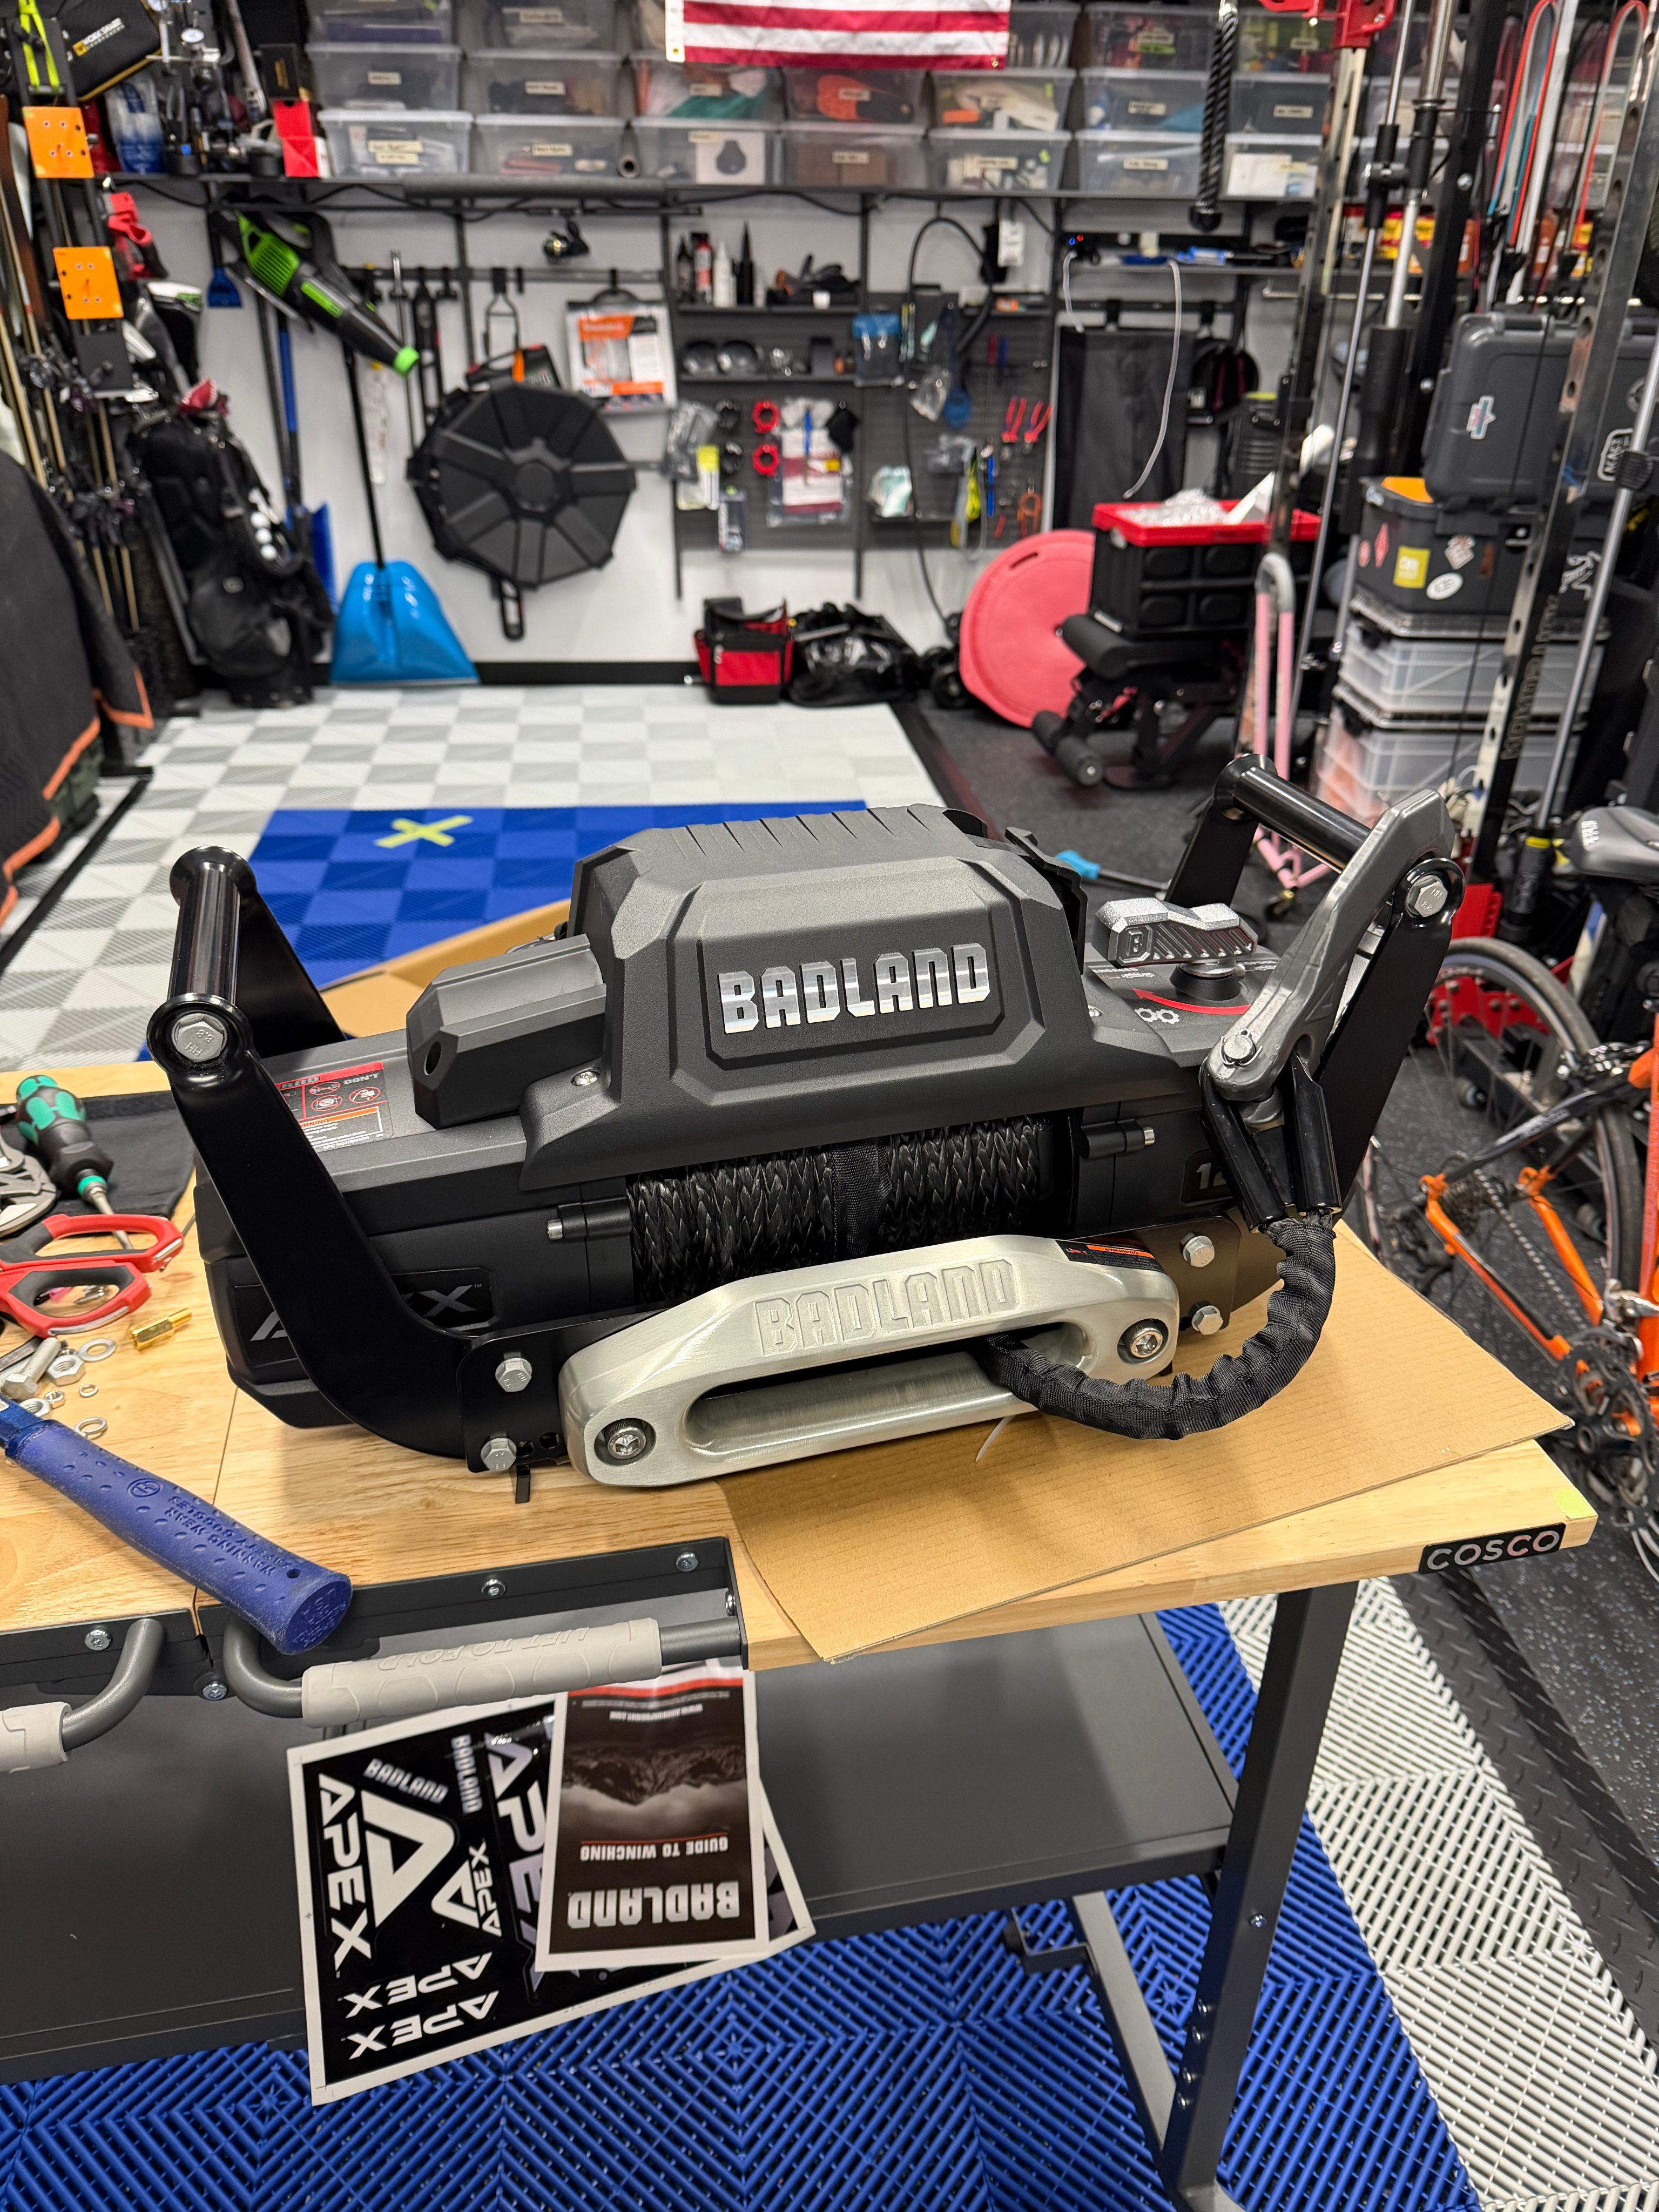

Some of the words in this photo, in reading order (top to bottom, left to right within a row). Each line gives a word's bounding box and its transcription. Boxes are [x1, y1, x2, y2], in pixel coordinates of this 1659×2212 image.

[719, 943, 990, 1034] BADLAND
[197, 1029, 213, 1042] 8.8
[343, 1073, 379, 1085] DON'T
[754, 1260, 1019, 1357] BADLAND
[168, 1496, 235, 1537] GOGGLES
[1427, 1530, 1560, 1570] COSCO
[378, 1645, 466, 1670] FOLD
[471, 1638, 512, 1656] TO
[522, 1627, 590, 1649] LIFT
[363, 1758, 449, 1804] BADLAND
[451, 1734, 483, 1815] BADLAND
[580, 1844, 656, 1862] WINCHING
[662, 1842, 680, 1858] TO
[686, 1836, 729, 1856] GUIDE
[319, 1773, 372, 1971] APEX
[469, 1842, 502, 1937] APEX
[567, 1880, 740, 1929] BADLAND
[343, 1951, 493, 2019] APEX
[346, 1990, 499, 2060] APEX
